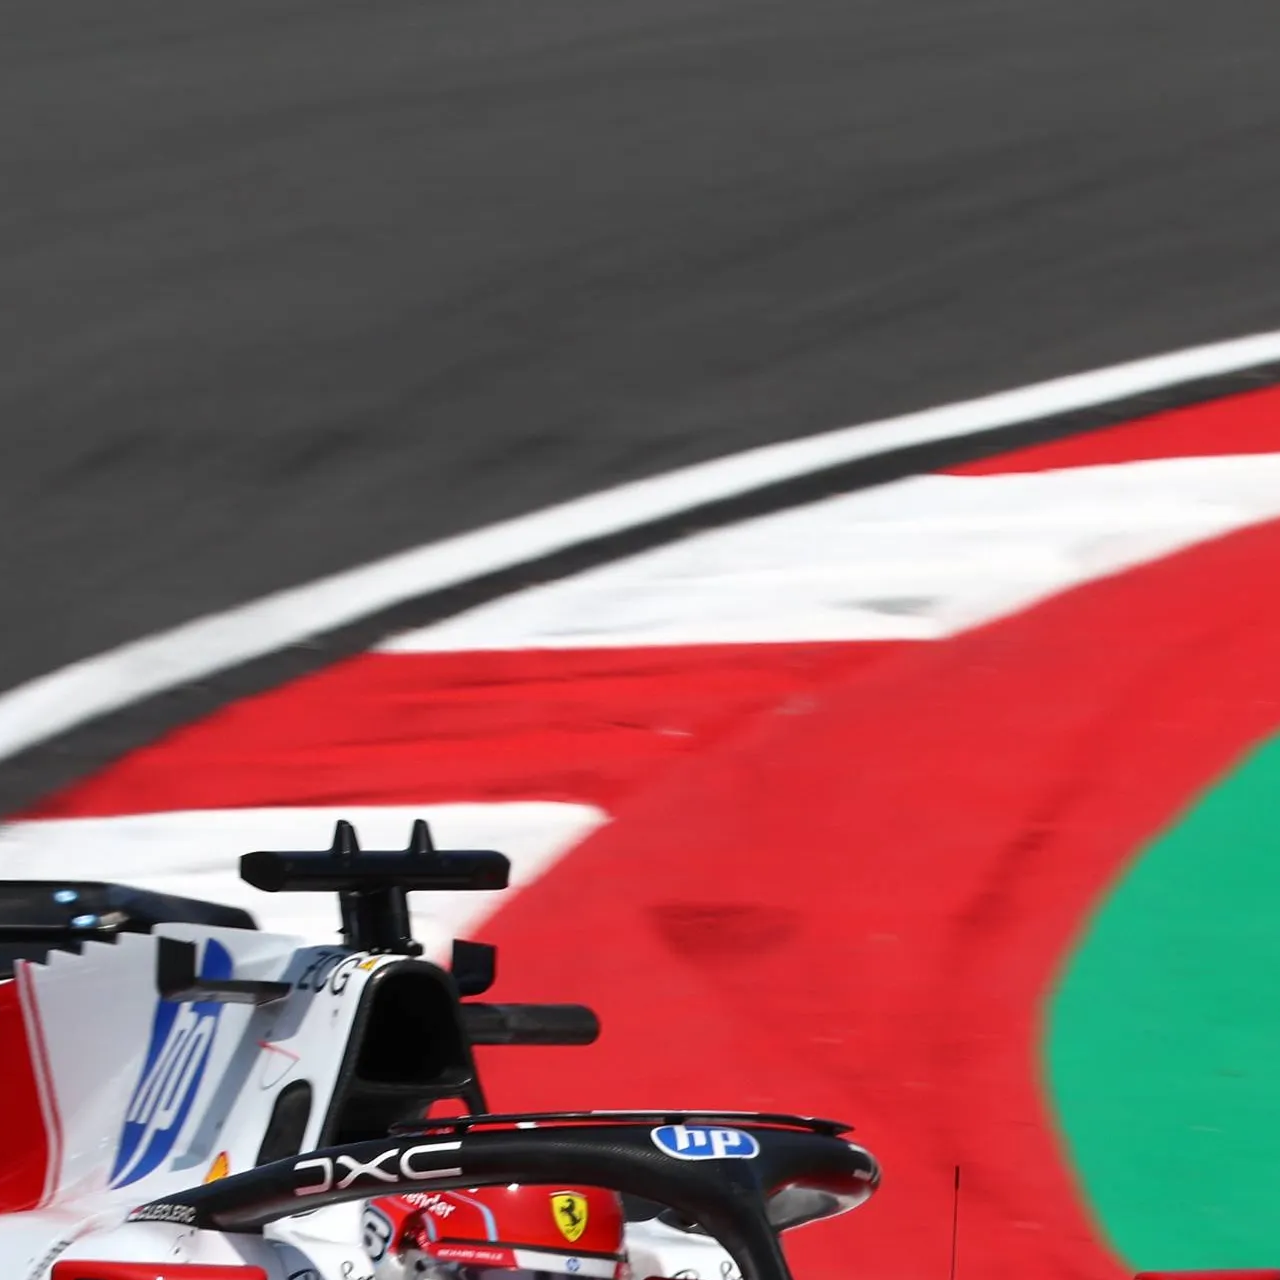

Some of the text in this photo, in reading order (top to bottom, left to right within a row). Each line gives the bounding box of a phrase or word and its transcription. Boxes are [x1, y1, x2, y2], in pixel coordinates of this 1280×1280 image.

[112, 1000, 217, 1188] hp
[673, 1125, 741, 1156] hp
[294, 1141, 463, 1196] DXC
